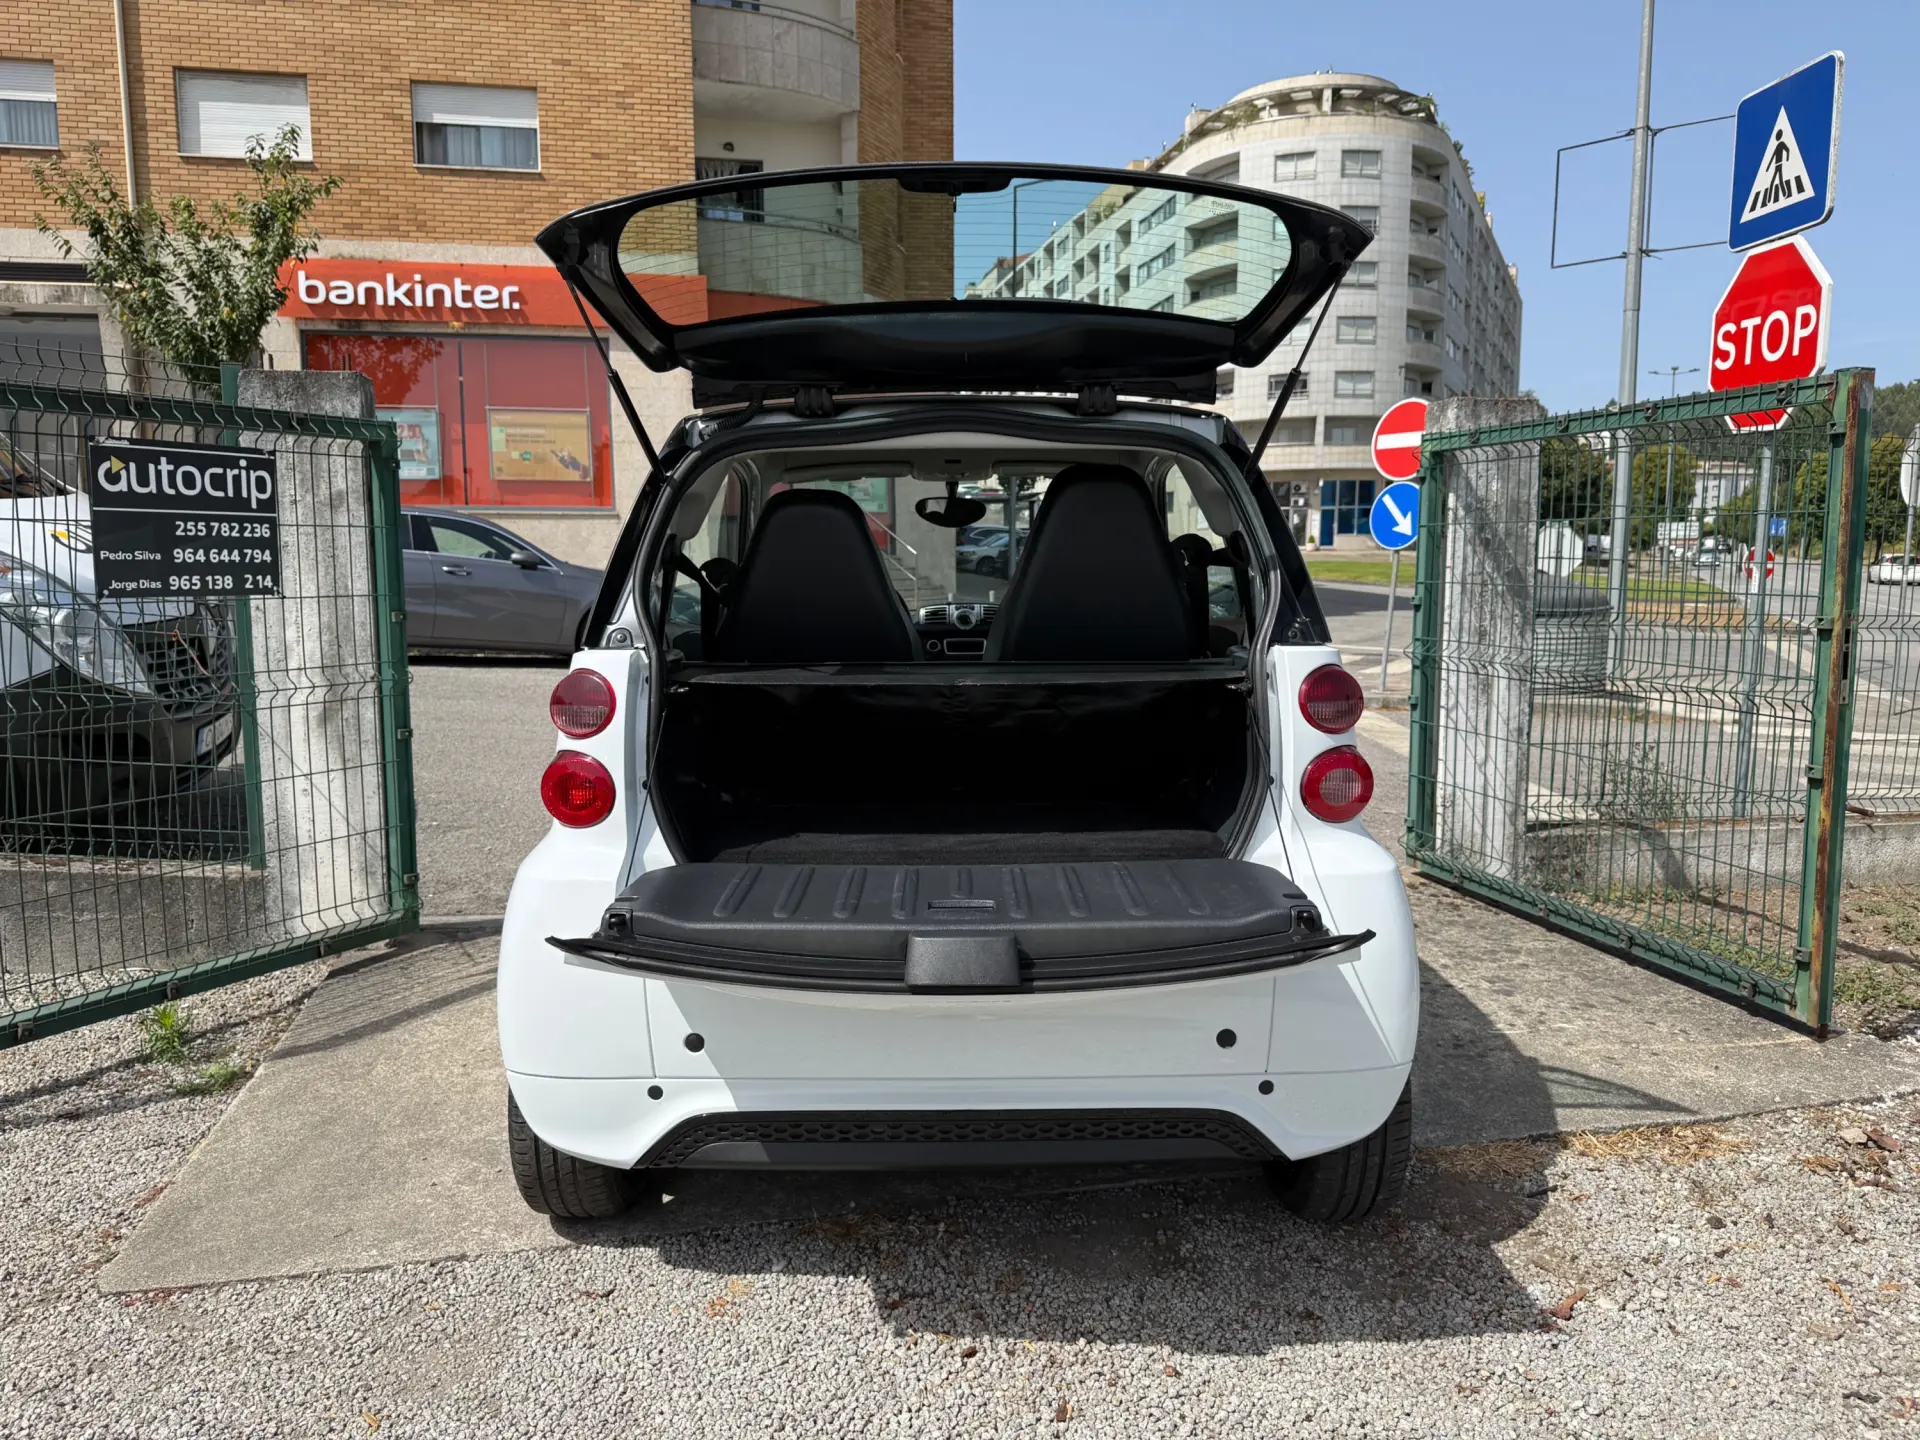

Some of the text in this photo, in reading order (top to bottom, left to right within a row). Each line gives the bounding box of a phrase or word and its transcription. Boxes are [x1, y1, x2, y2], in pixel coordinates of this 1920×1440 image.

[1714, 303, 1818, 371] STOP
[97, 455, 272, 509] autocrip
[175, 521, 271, 538] 255 782 236
[100, 548, 272, 563] Pedro Silva 964 644 794
[108, 574, 273, 591] Jorge Dias 965 138 214
